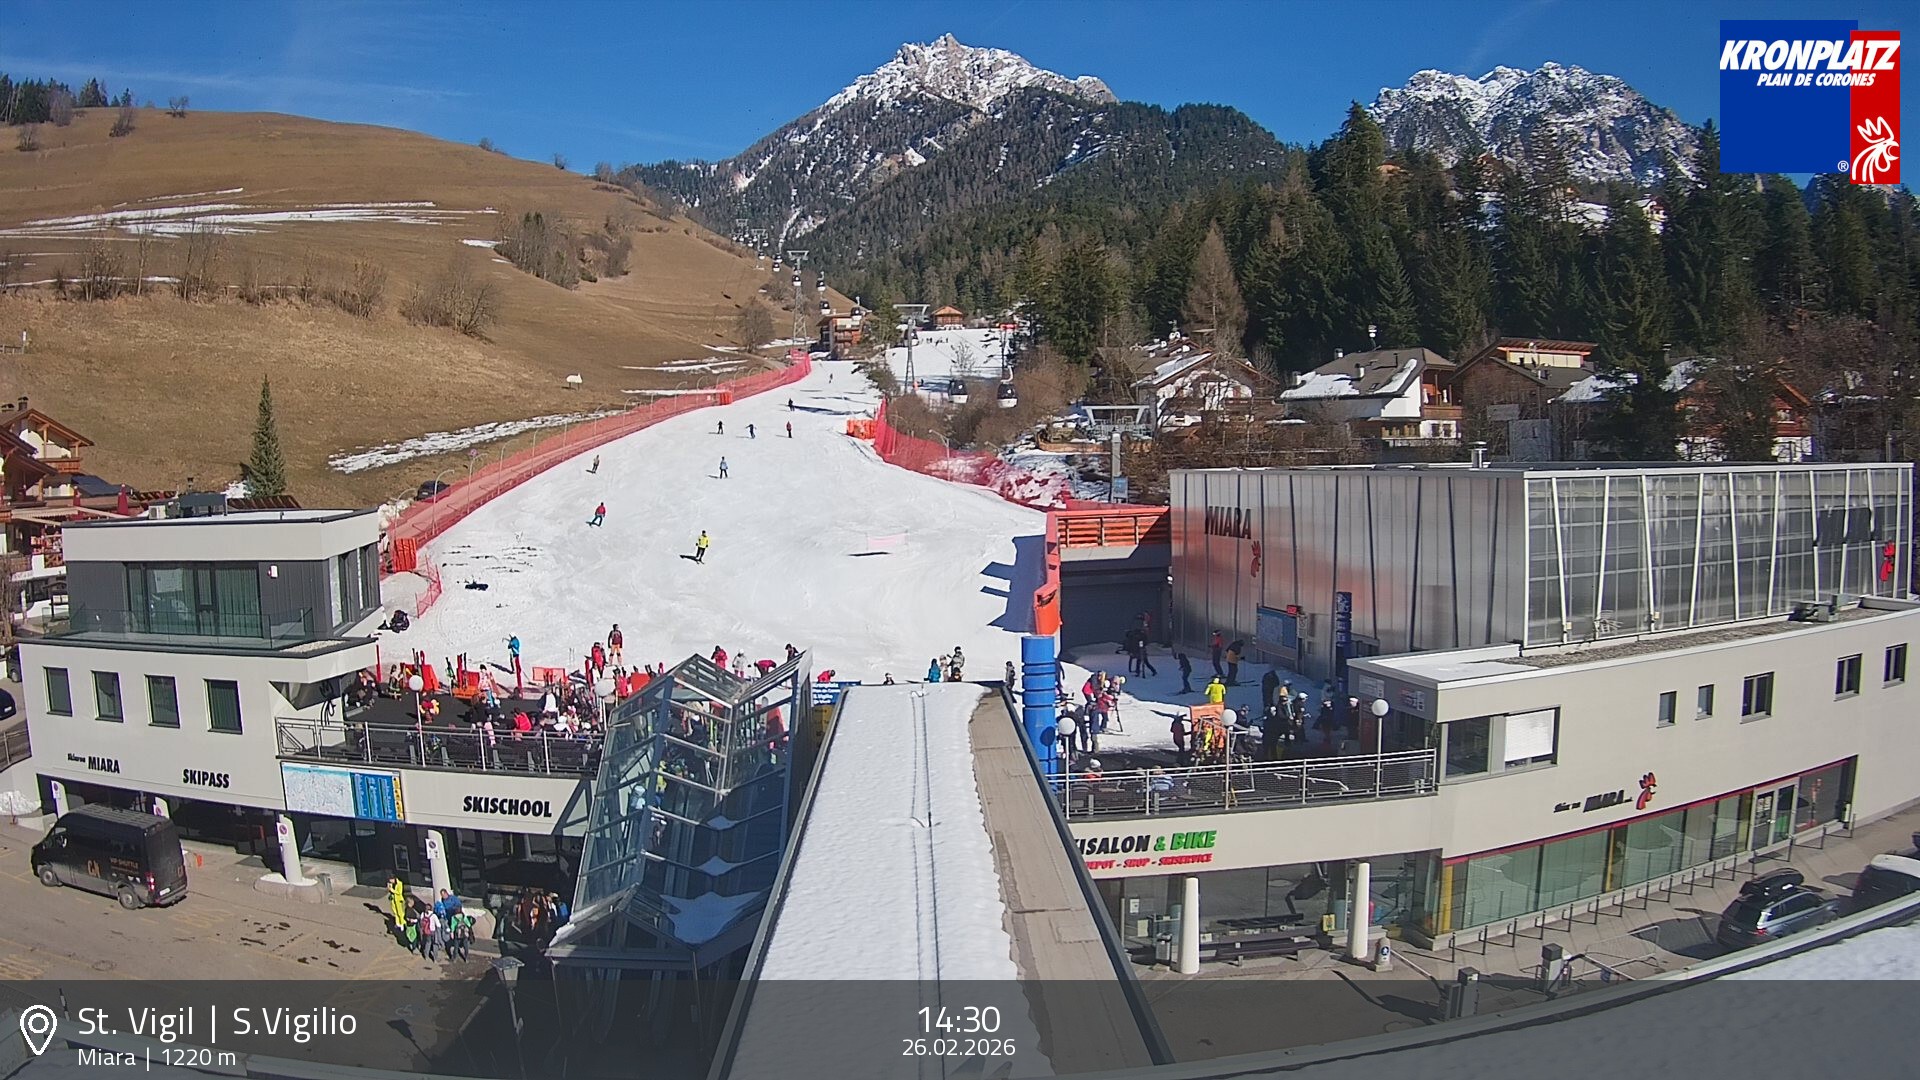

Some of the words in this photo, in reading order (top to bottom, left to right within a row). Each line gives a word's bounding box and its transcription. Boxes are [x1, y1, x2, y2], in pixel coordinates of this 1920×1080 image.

[1204, 506, 1252, 540] MIARA
[88, 756, 120, 774] MIARA
[183, 768, 230, 788] SKIPASS
[463, 795, 552, 818] SKISCHOOL
[1154, 836, 1166, 852] &
[1170, 830, 1218, 850] BIKE
